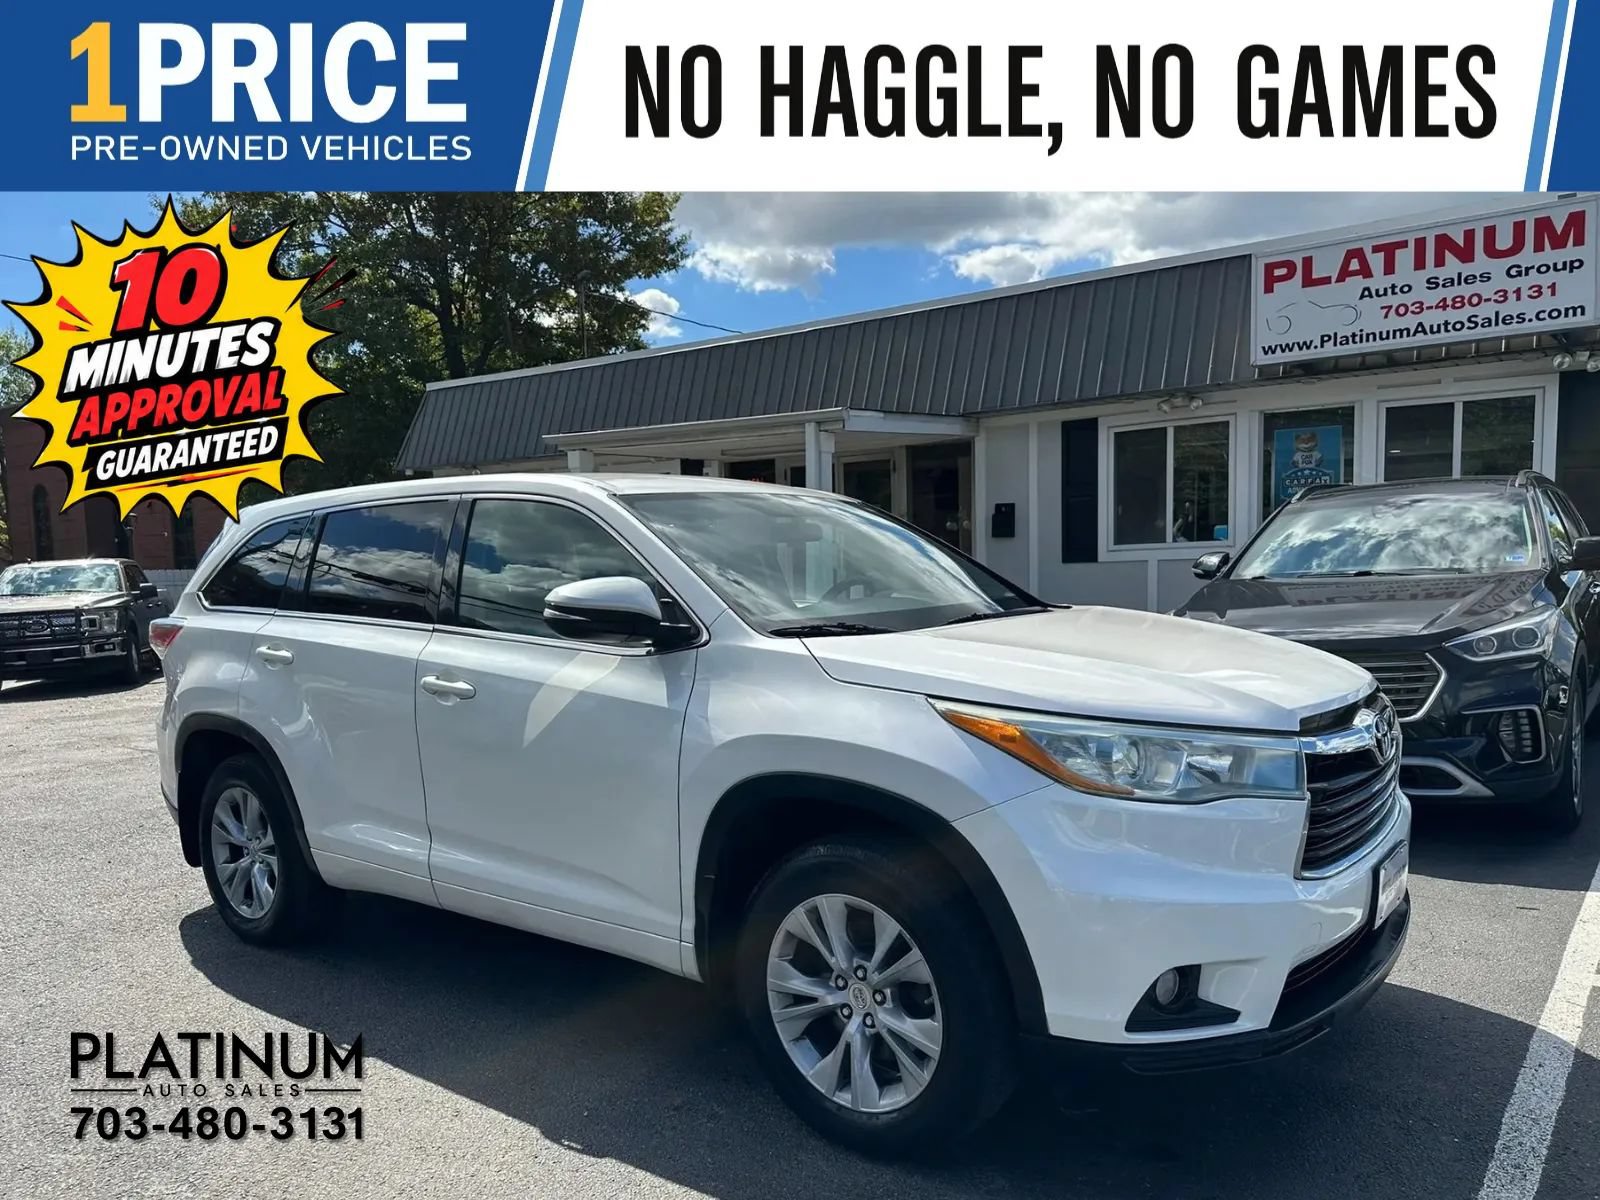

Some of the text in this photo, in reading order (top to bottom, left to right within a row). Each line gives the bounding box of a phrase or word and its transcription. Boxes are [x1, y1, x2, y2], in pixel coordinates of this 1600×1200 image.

[1263, 209, 1587, 294] PLATINUM
[1358, 256, 1585, 301] Auto Sales Group
[1380, 282, 1558, 319] 703-480-3131
[1261, 303, 1586, 356] www.PlatinumAutoSales.com
[1285, 476, 1330, 486] CARFAX
